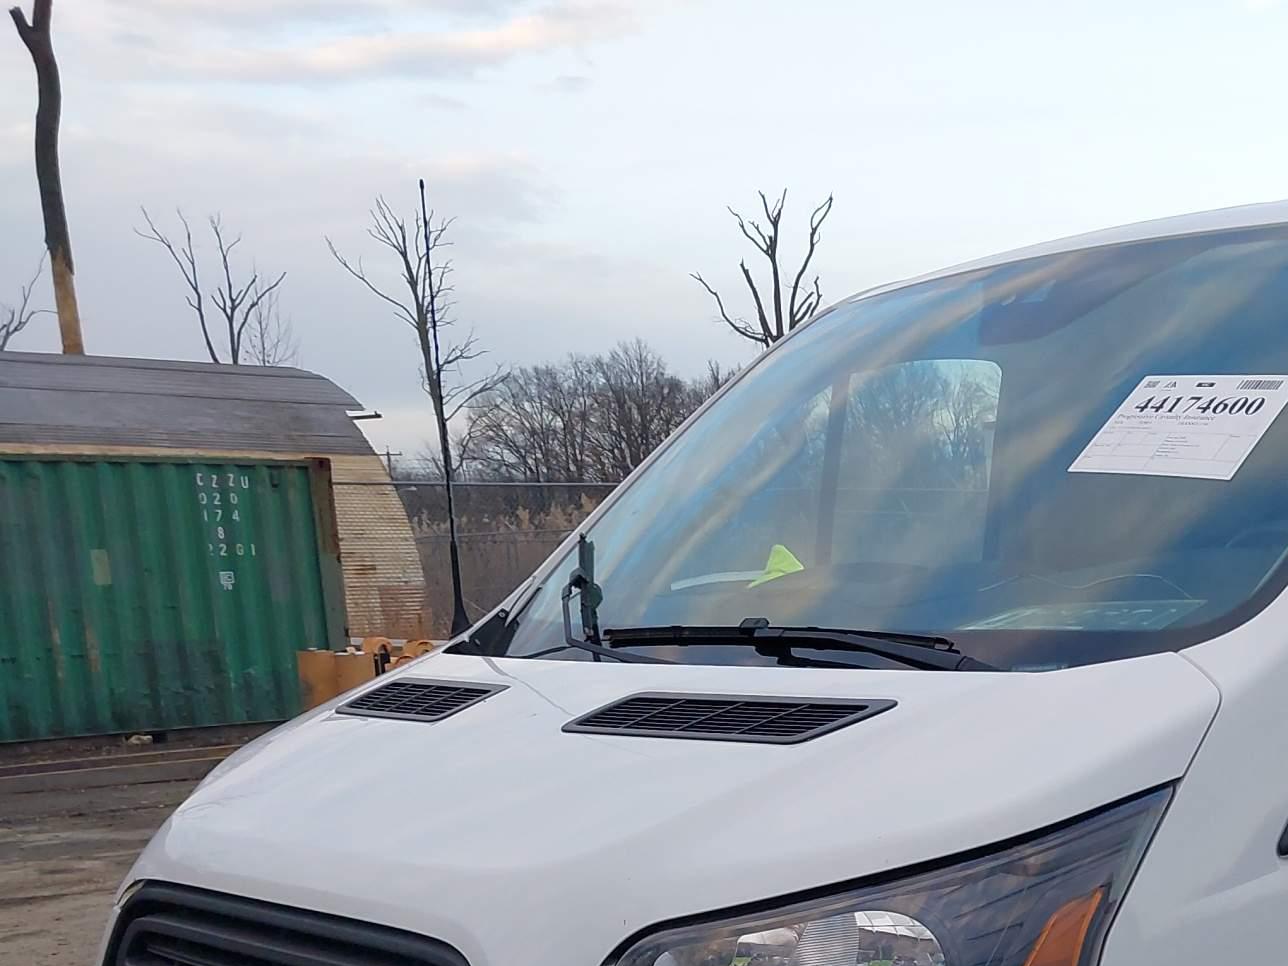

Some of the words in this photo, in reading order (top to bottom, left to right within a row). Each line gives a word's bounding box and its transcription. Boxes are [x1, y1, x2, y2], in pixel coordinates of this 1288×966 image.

[1134, 395, 1266, 415] 44174600
[198, 493, 238, 505] 020
[203, 510, 241, 522] 174
[217, 526, 225, 539] 8
